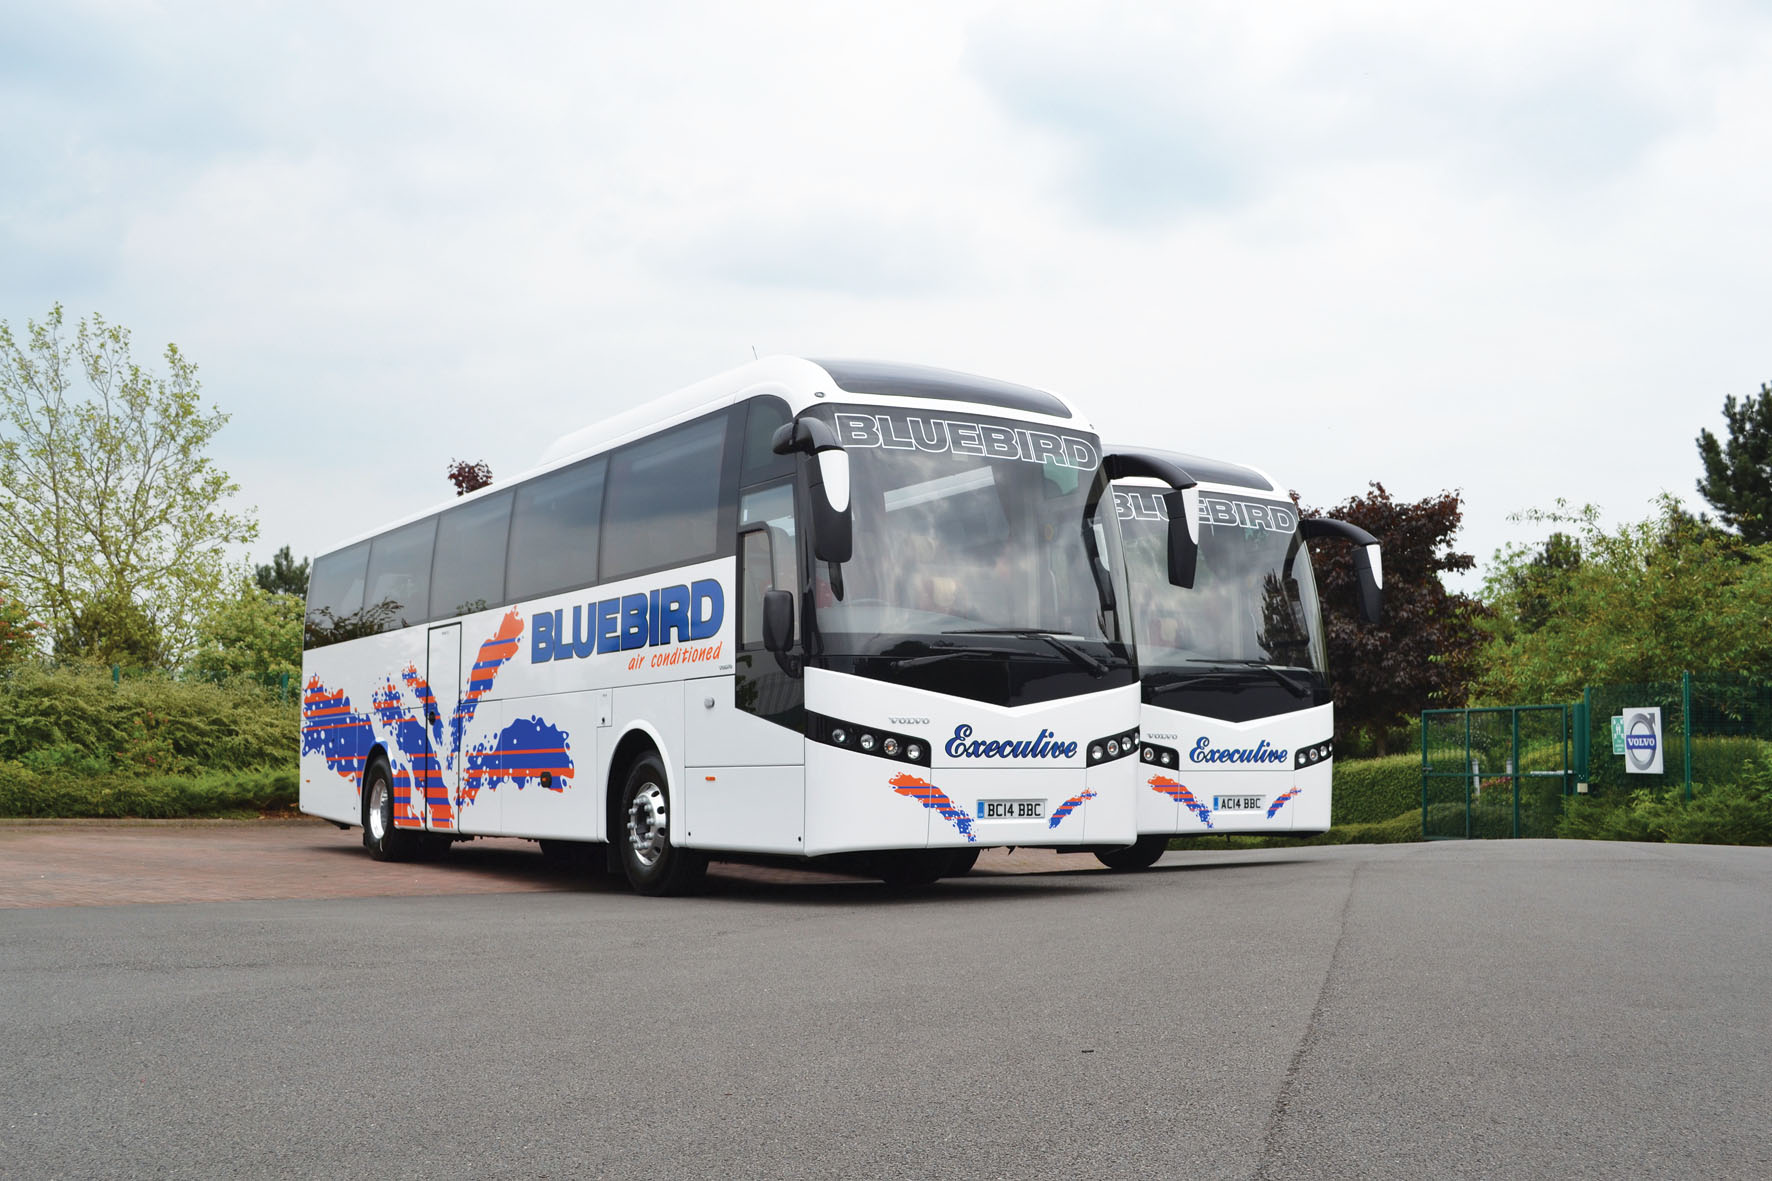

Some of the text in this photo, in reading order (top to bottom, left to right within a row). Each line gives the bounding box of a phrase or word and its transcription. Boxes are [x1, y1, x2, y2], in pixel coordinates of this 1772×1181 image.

[835, 413, 1099, 471] BLUEBIRD
[531, 578, 725, 664] BLUEBIRD
[628, 641, 723, 671] air conditioned
[888, 717, 930, 725] VOLVO
[945, 724, 1078, 758] Executive
[1189, 736, 1288, 763] Executive
[1627, 738, 1655, 746] VOLVO
[987, 803, 1041, 817] BC14 BBC
[1221, 798, 1261, 809] AC14 BBC
